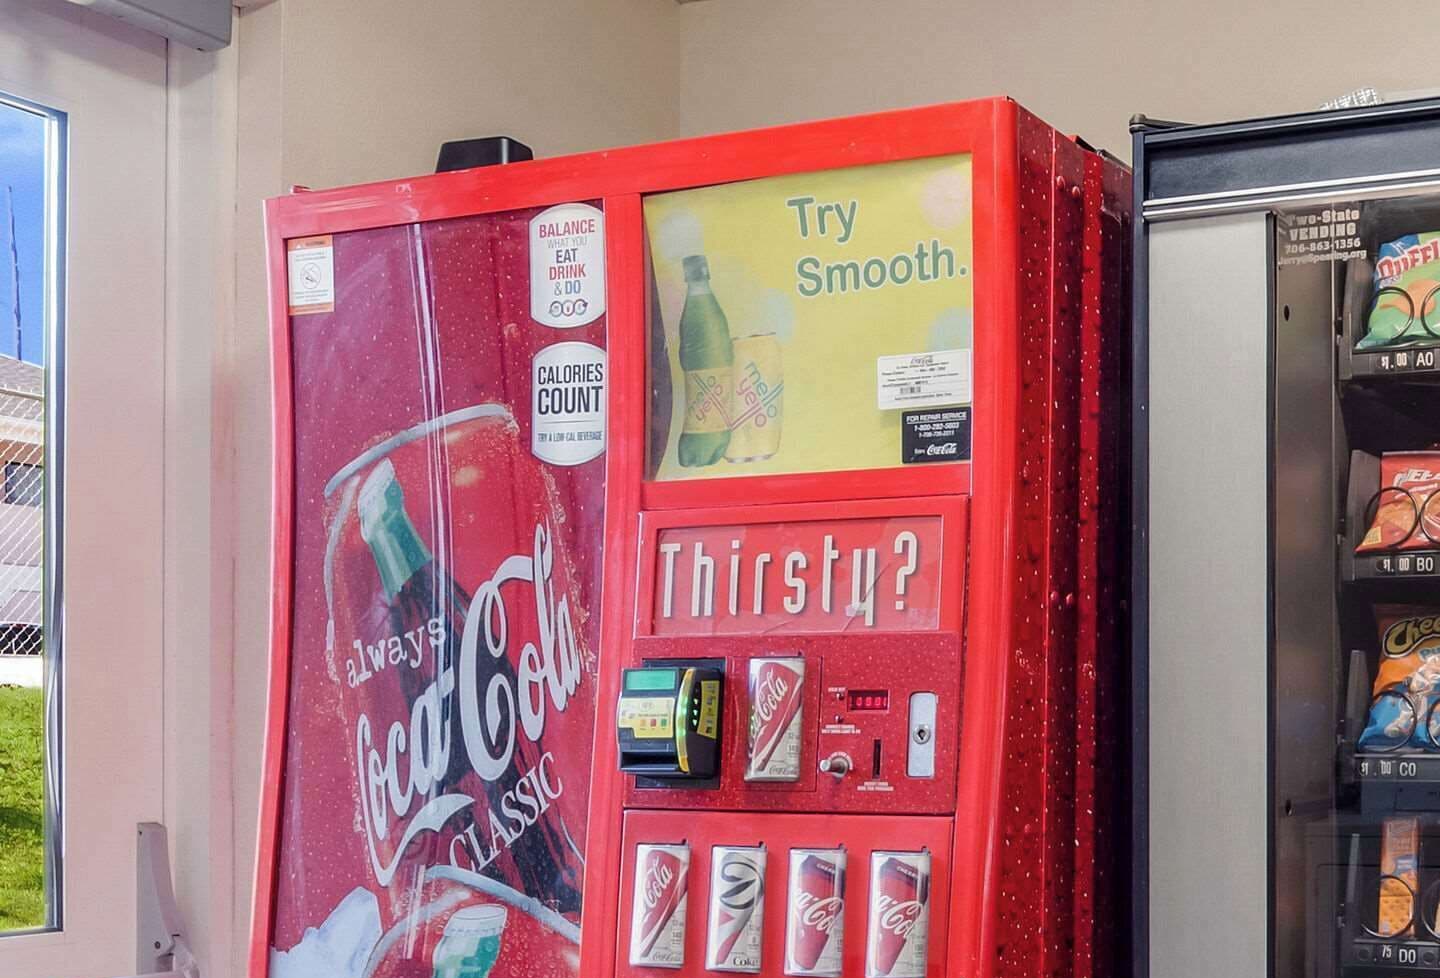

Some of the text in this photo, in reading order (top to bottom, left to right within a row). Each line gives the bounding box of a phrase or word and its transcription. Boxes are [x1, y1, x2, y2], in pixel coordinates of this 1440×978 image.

[539, 218, 595, 239] BALANCE
[787, 197, 857, 243] Try
[1290, 222, 1356, 241] VENDING
[547, 236, 587, 249] WHAT YOU
[555, 248, 578, 264] EAT
[549, 264, 586, 280] DRINK
[798, 239, 967, 297] Smooth.
[554, 280, 581, 296] & DO
[1416, 351, 1433, 366] A0
[538, 363, 603, 386] CALORIES
[538, 386, 603, 415] COUNT
[1416, 557, 1433, 571] B0
[661, 530, 919, 627] Thirsty?
[346, 615, 448, 688] always
[1400, 763, 1416, 777] C0
[449, 751, 563, 874] CLASSIC
[1399, 949, 1416, 964] D0
